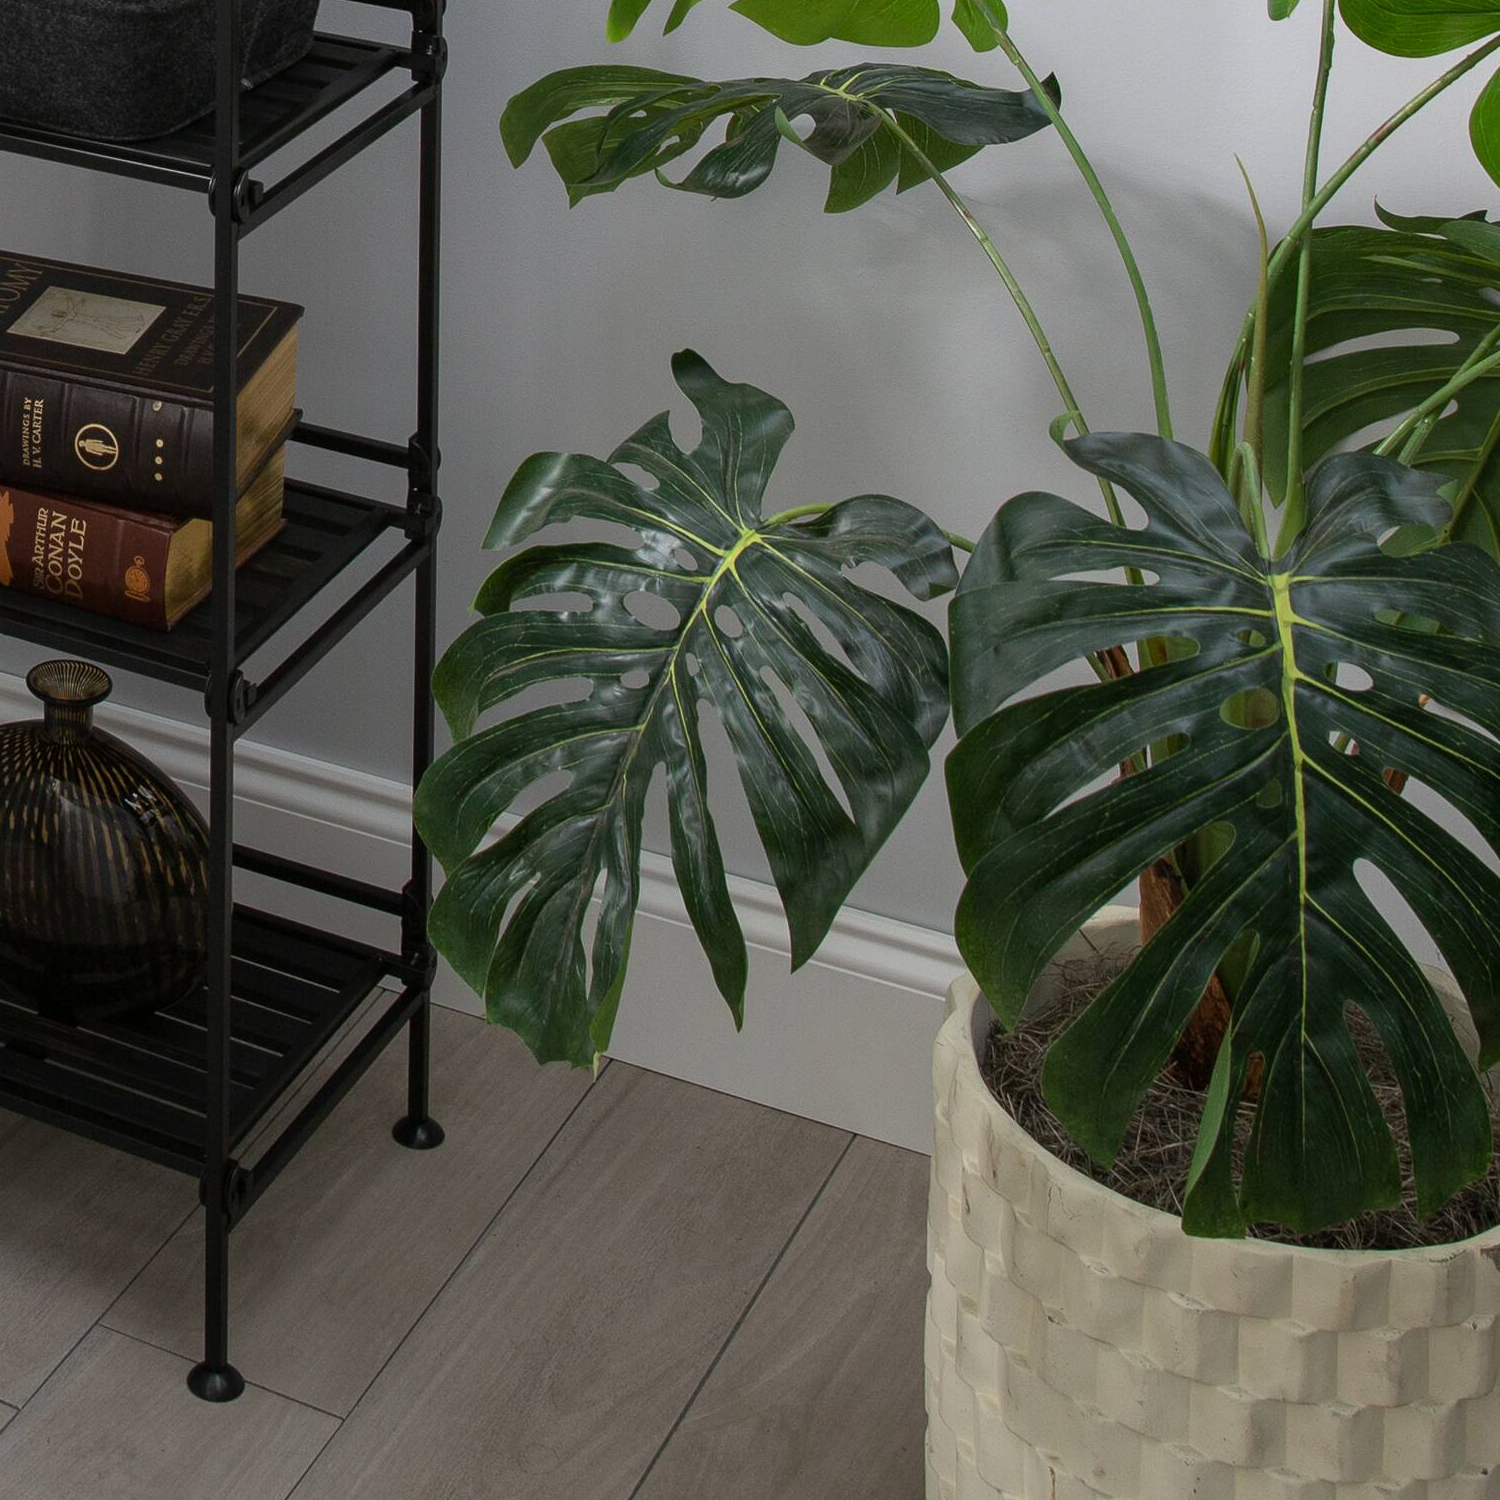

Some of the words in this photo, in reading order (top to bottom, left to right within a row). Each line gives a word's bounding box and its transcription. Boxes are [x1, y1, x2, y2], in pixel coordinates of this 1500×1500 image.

[23, 396, 32, 410] BY
[32, 398, 44, 444] CARTER
[22, 412, 32, 466] DRAWINGS
[32, 507, 49, 571] ARTHUR
[44, 510, 68, 595] CONAN
[65, 518, 87, 600] DOYLE
[32, 568, 45, 590] SIR
